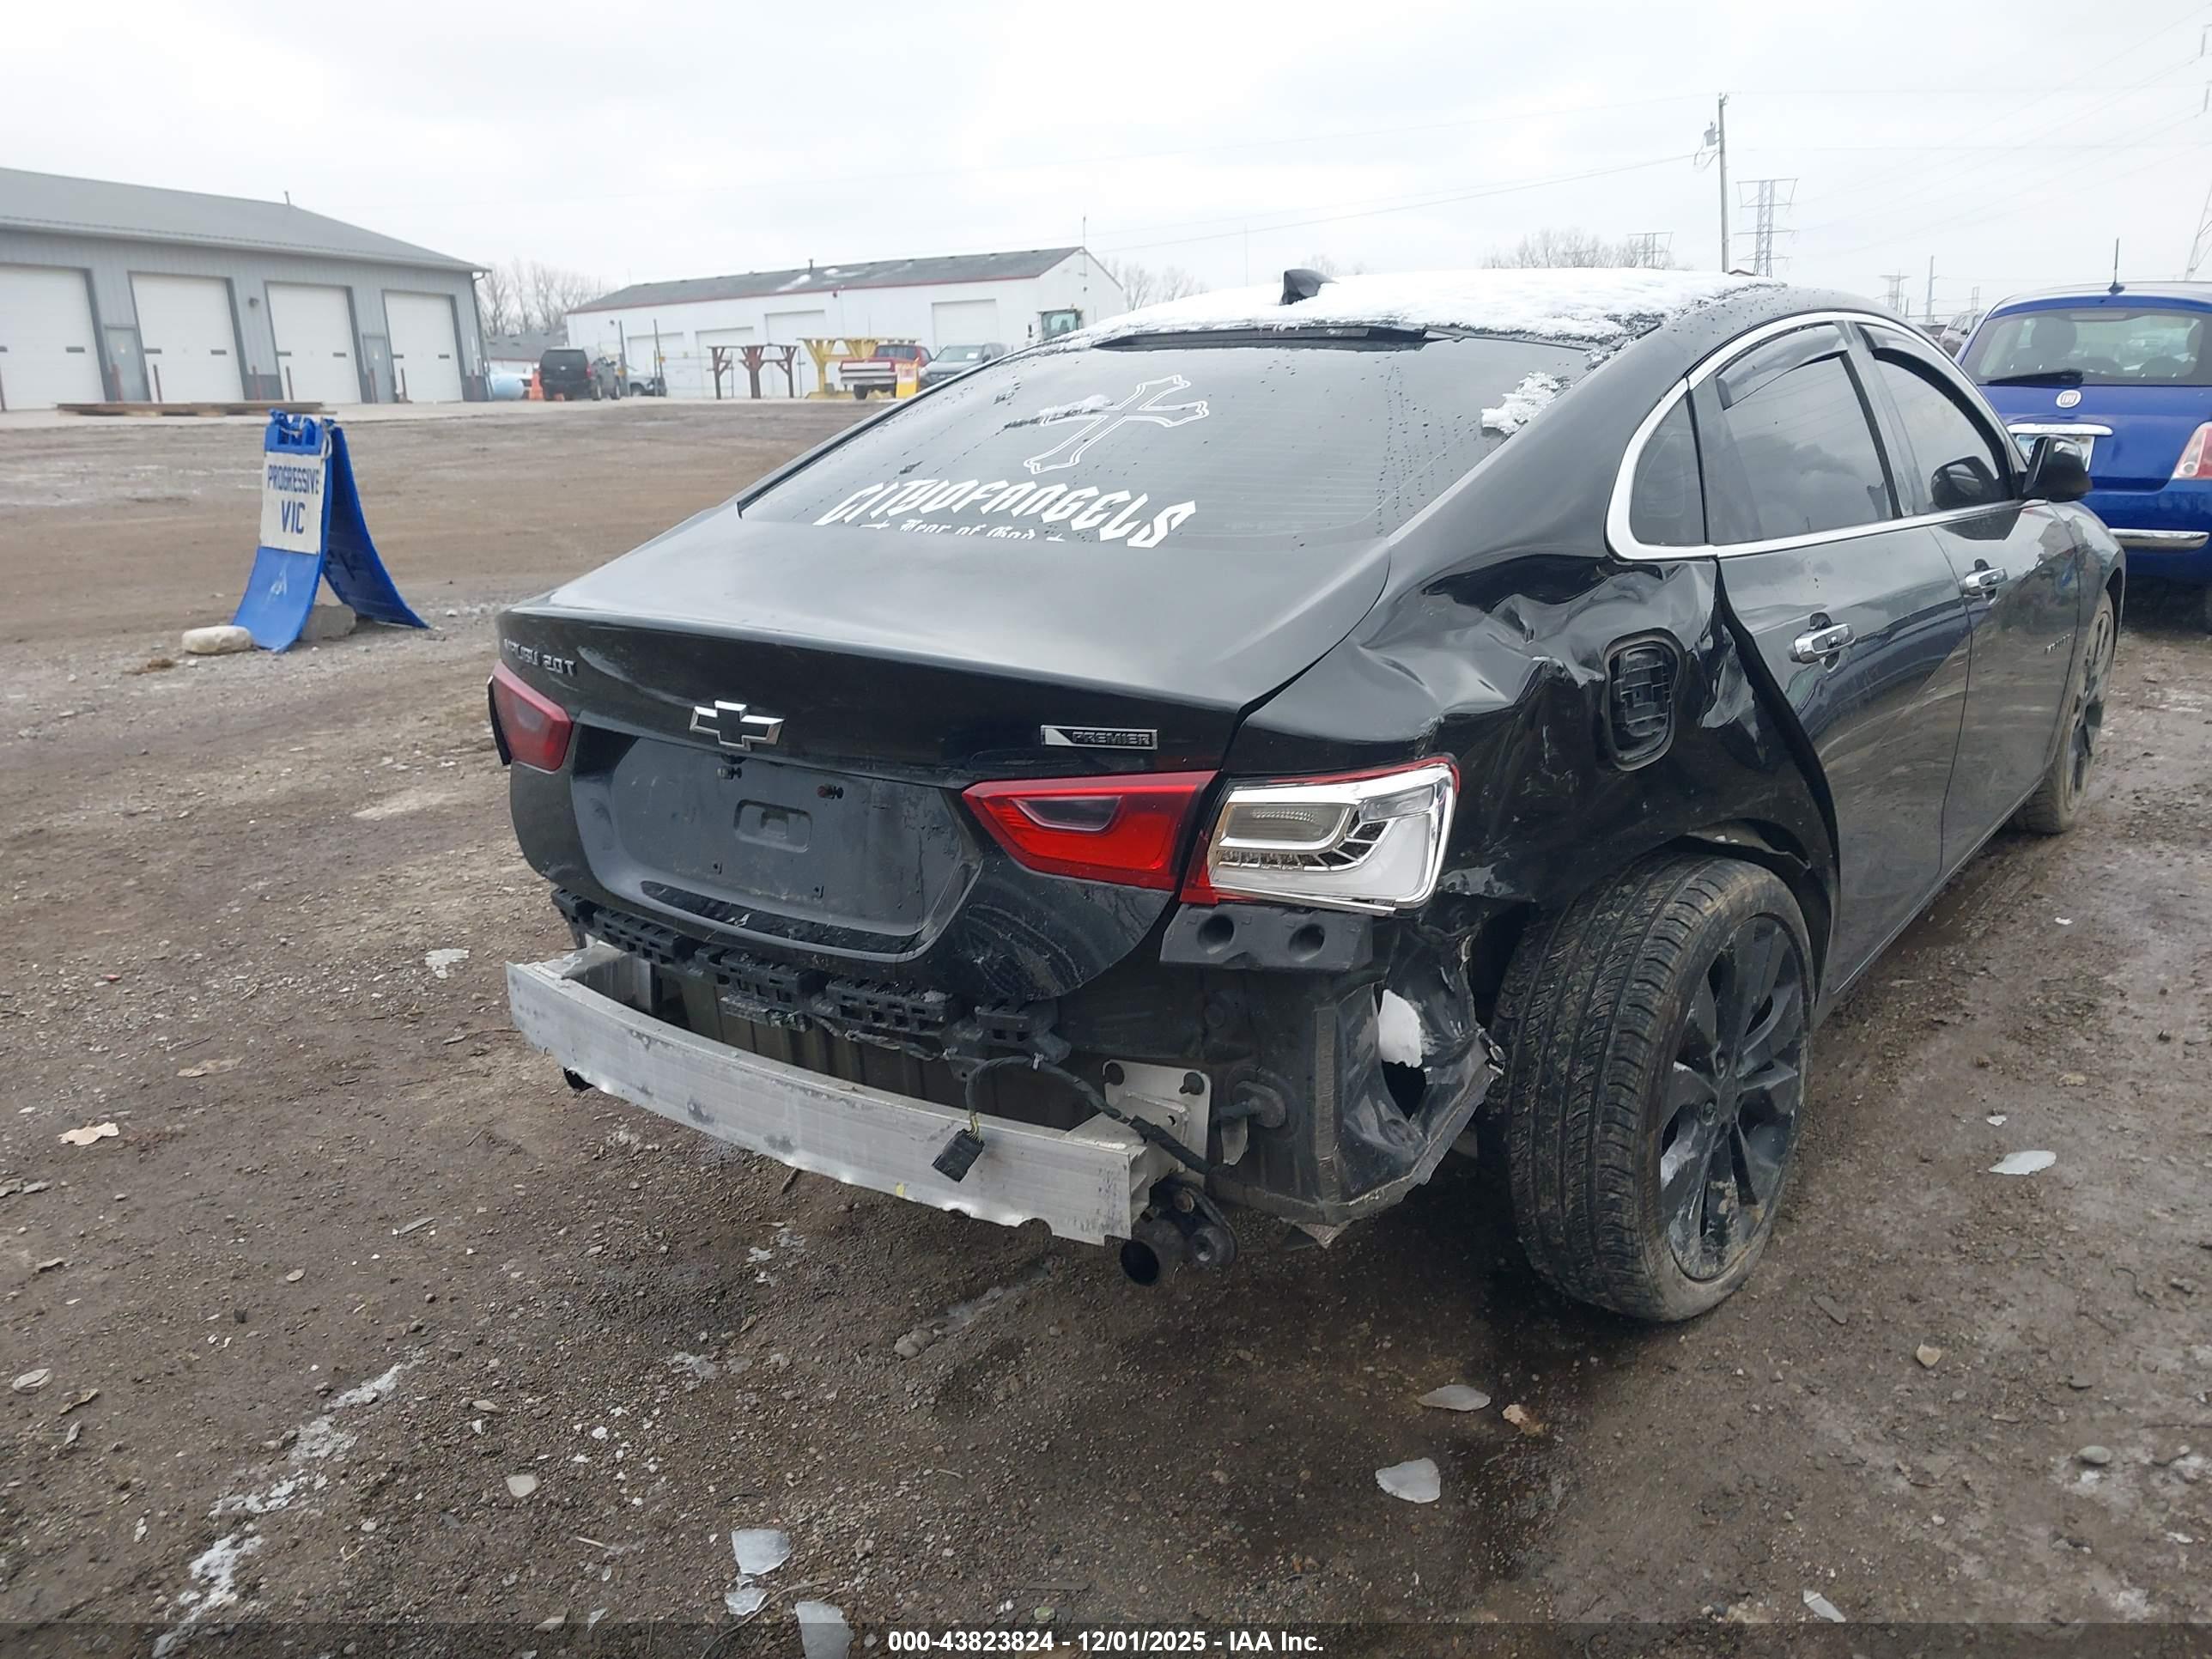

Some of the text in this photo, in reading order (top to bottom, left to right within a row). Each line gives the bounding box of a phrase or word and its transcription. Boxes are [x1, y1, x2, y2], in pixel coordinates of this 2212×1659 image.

[267, 465, 319, 495] PROGRESSIVE
[282, 500, 306, 534] VIC
[1072, 731, 1151, 745] PREMIER
